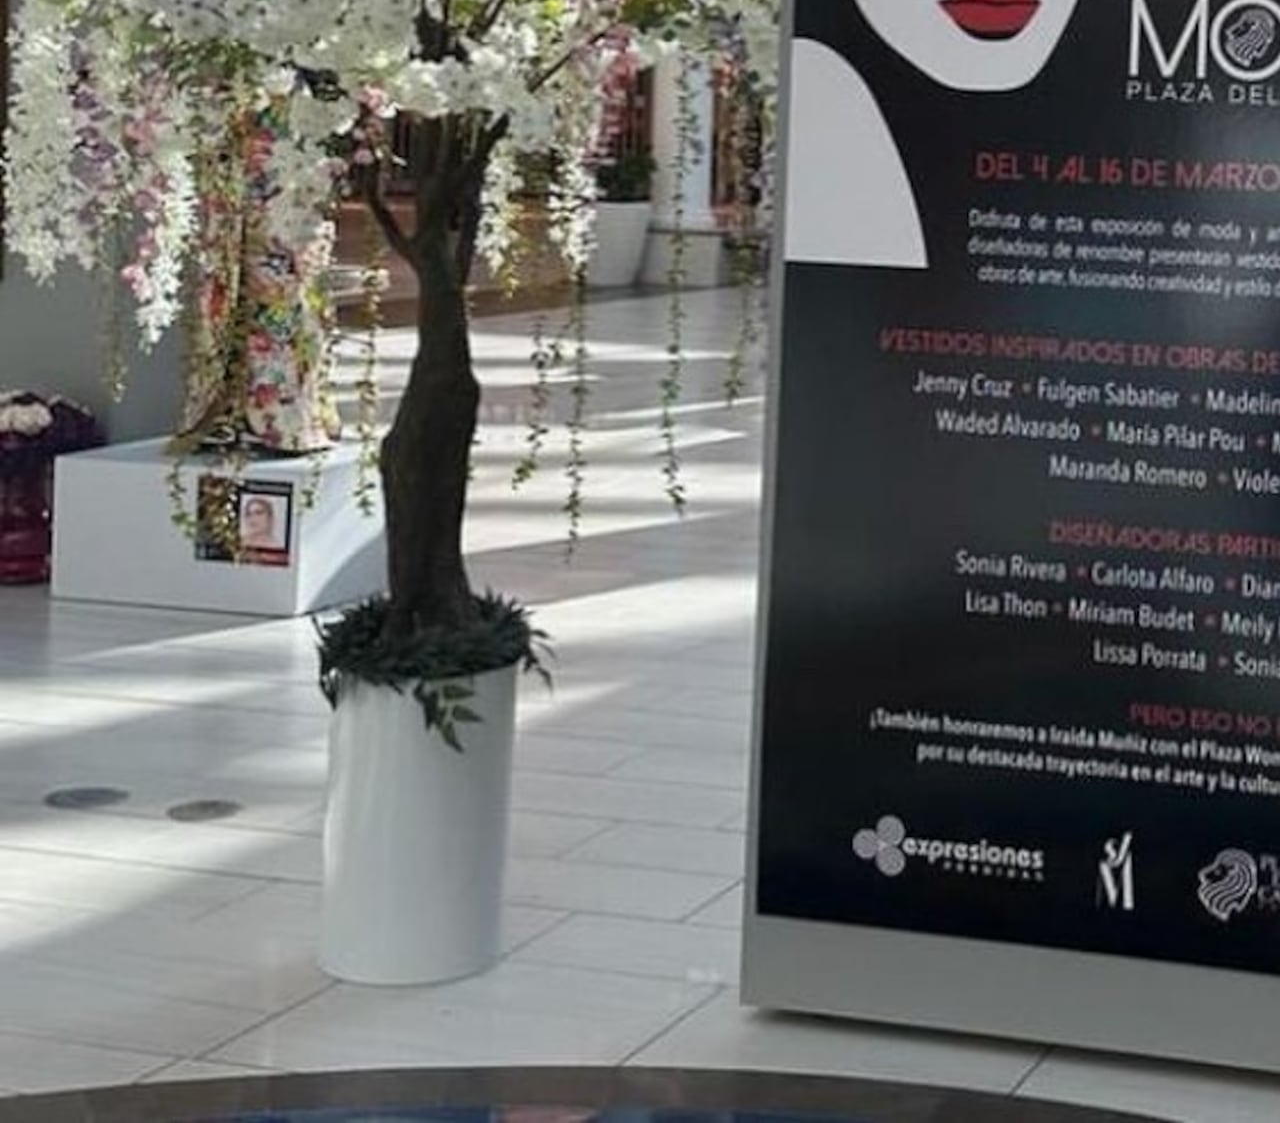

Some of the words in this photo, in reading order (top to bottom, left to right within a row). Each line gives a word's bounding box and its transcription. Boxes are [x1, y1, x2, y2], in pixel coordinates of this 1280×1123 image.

[1126, 81, 1213, 102] PLAZA
[976, 153, 1024, 180] DEL
[1032, 155, 1049, 181] 4
[1057, 155, 1093, 183] AL
[1100, 157, 1122, 185] 16
[1130, 158, 1167, 187] DE
[1028, 212, 1047, 231] de
[1055, 215, 1084, 232] esta
[1172, 218, 1191, 238] de
[1200, 221, 1242, 240] moda
[1053, 240, 1072, 258] de
[1075, 243, 1145, 262] renombre
[976, 265, 1016, 283] obras
[1018, 264, 1035, 285] de
[1068, 268, 1145, 289] fusionando
[1147, 274, 1222, 293] creatividad
[1234, 279, 1272, 297] estilo
[879, 329, 985, 355] VESTIDOS
[990, 335, 1125, 364] INSPIRADOS
[1131, 344, 1159, 366] EN
[1166, 346, 1246, 372] OBRAS
[912, 370, 968, 401] Jenny
[971, 374, 1012, 398] Cruz
[1037, 377, 1099, 408] Fulgen
[1104, 382, 1180, 408] Sabatier
[935, 409, 998, 435] Waded
[1002, 413, 1080, 441] Alvarado
[1164, 424, 1204, 449] Pilar
[1210, 428, 1245, 452] Pou
[1049, 453, 1130, 483] Maranda
[1134, 460, 1207, 490] Romero
[956, 549, 1006, 576] Sonia
[1010, 554, 1067, 581] Rivera
[1091, 561, 1156, 589] Carlota
[1159, 566, 1214, 594] Alfaro
[965, 589, 999, 614] Lisa
[1003, 591, 1048, 617] Thon
[1068, 597, 1135, 625] Miriam
[1138, 604, 1194, 632] Budet
[1221, 610, 1274, 645] Meily
[1093, 639, 1138, 665] Lissa
[1141, 642, 1207, 672] Porrata
[1130, 703, 1186, 727] PERO
[1190, 708, 1233, 732] ESO
[1236, 712, 1271, 736] NO
[943, 714, 1035, 741] honraremos
[1037, 727, 1047, 743] a
[1050, 725, 1095, 747] Iraida
[1151, 738, 1179, 756] con
[1182, 738, 1197, 757] el
[1200, 739, 1242, 762] Plaza
[916, 743, 944, 764] por
[947, 745, 965, 763] su
[967, 745, 1044, 770] destacada
[1046, 753, 1127, 777] trayectoria
[1131, 764, 1151, 780] en
[1155, 763, 1170, 782] el
[1173, 767, 1203, 786] arte
[1207, 773, 1218, 793] y
[1221, 770, 1236, 790] la
[902, 837, 1044, 868] expresiones
